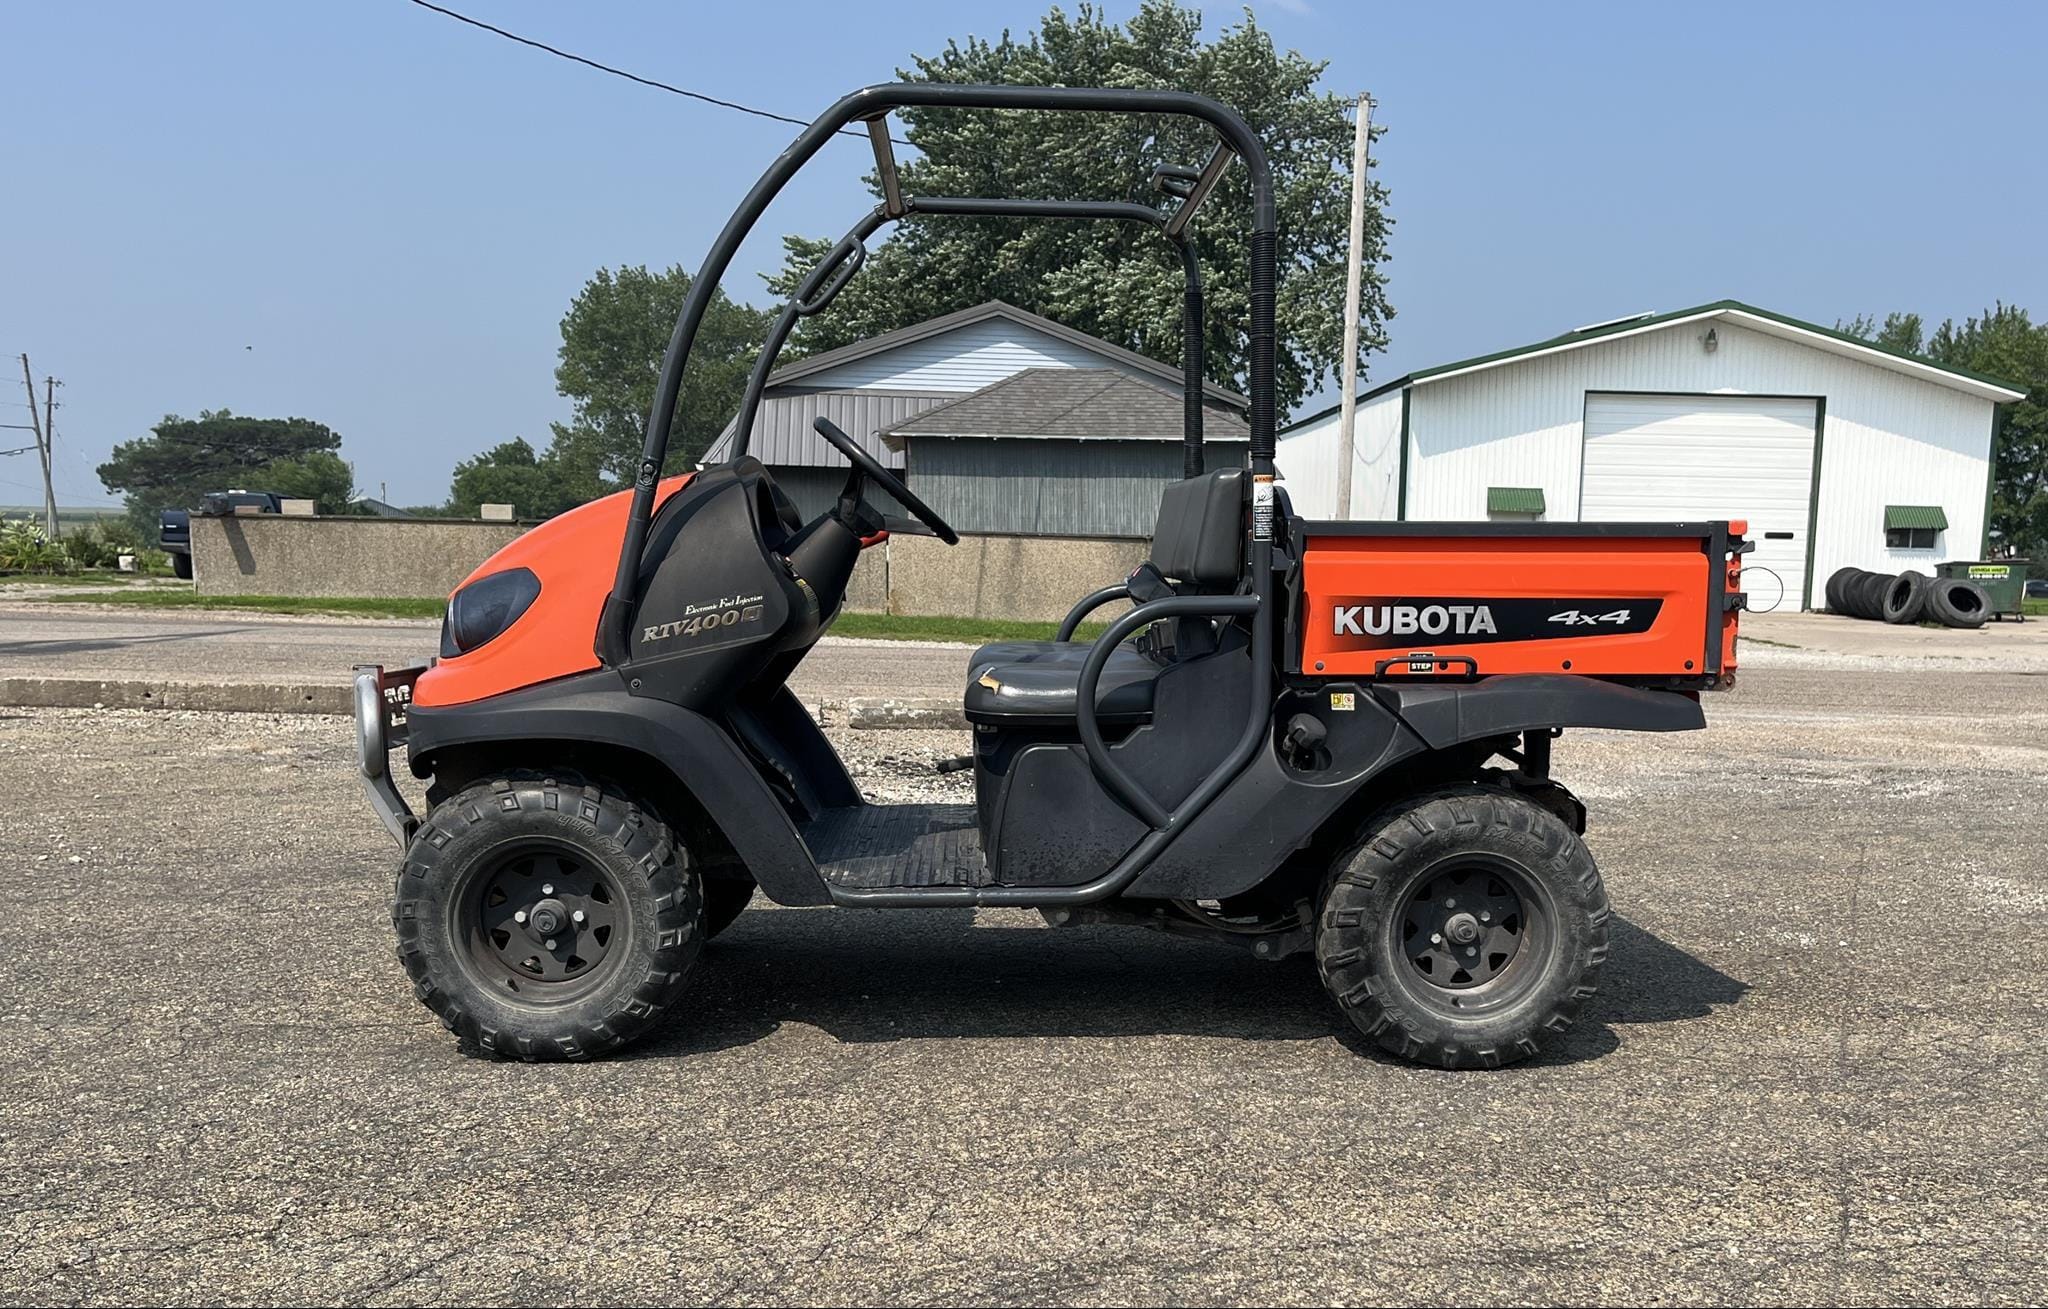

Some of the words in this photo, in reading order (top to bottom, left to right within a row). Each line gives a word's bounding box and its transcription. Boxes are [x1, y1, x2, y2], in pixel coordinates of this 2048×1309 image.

[718, 598, 734, 609] Fuel
[735, 595, 763, 606] Injection
[1334, 605, 1498, 635] KUBOTA
[1547, 609, 1631, 626] 4x4
[1411, 662, 1432, 670] STEP
